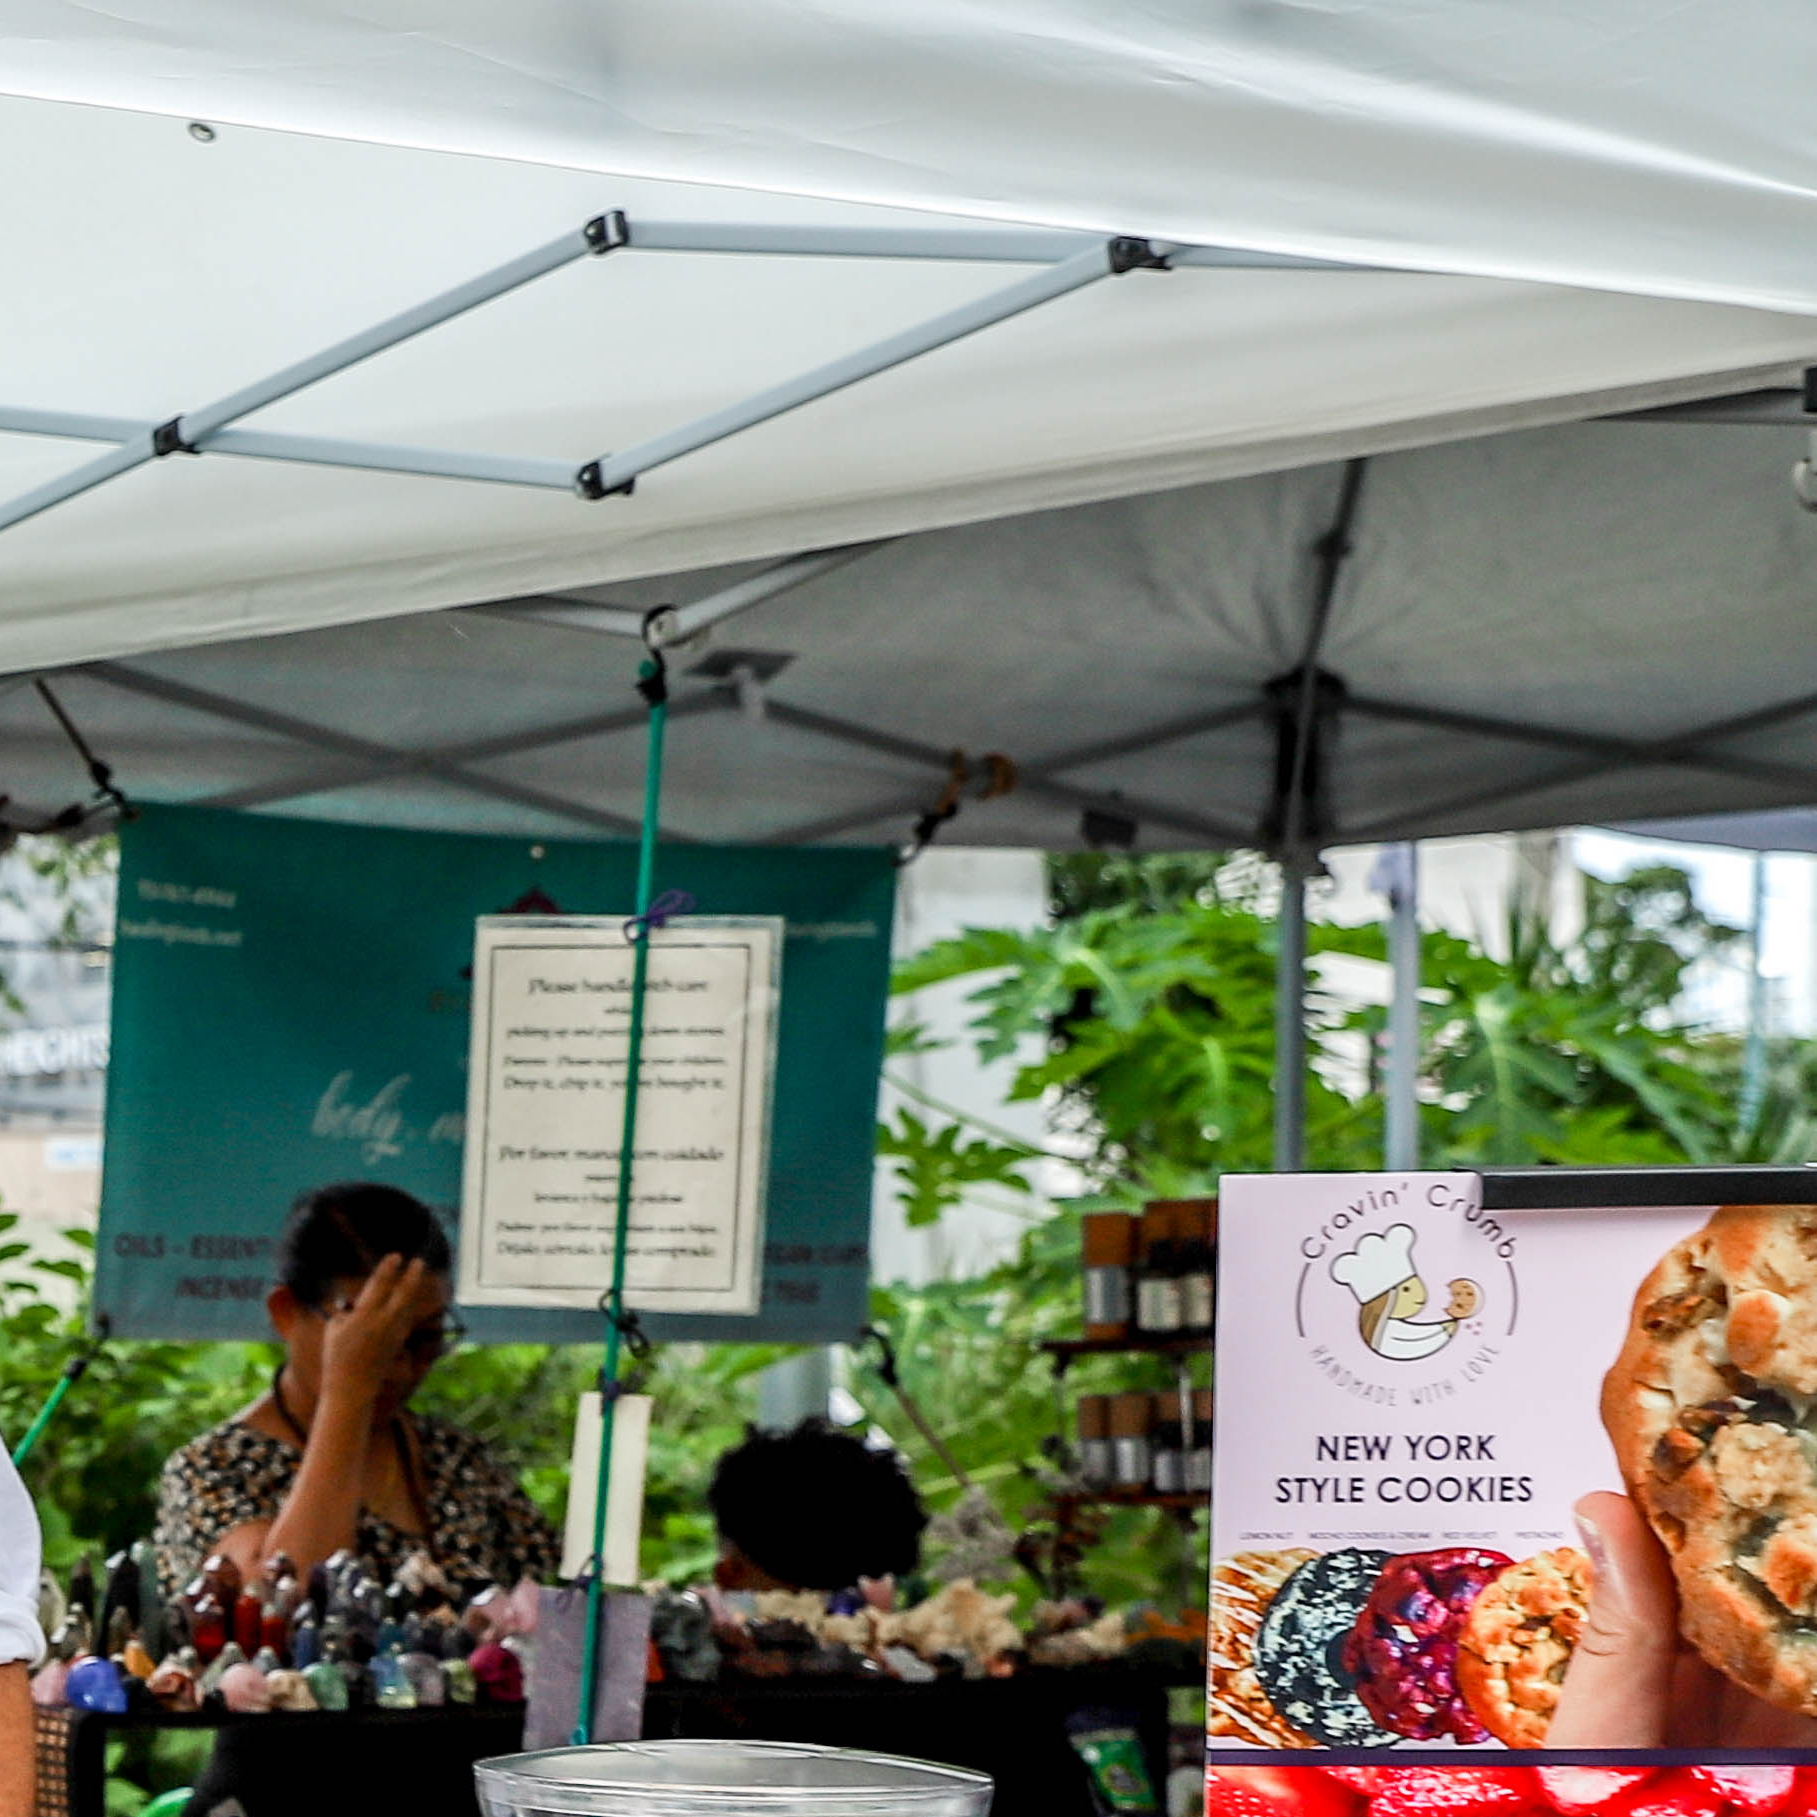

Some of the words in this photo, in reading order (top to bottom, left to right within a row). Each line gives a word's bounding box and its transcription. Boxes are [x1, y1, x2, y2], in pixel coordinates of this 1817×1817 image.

[1301, 1182, 1409, 1260] Cravin'
[1427, 1184, 1518, 1259] Crumb
[1310, 1345, 1398, 1407] HANDMADE
[1461, 1345, 1501, 1383] LOVE
[1315, 1434, 1392, 1462] NEW
[1403, 1434, 1497, 1462] YORK
[1275, 1477, 1365, 1504] STYLE
[1376, 1475, 1534, 1503] COOKIES
